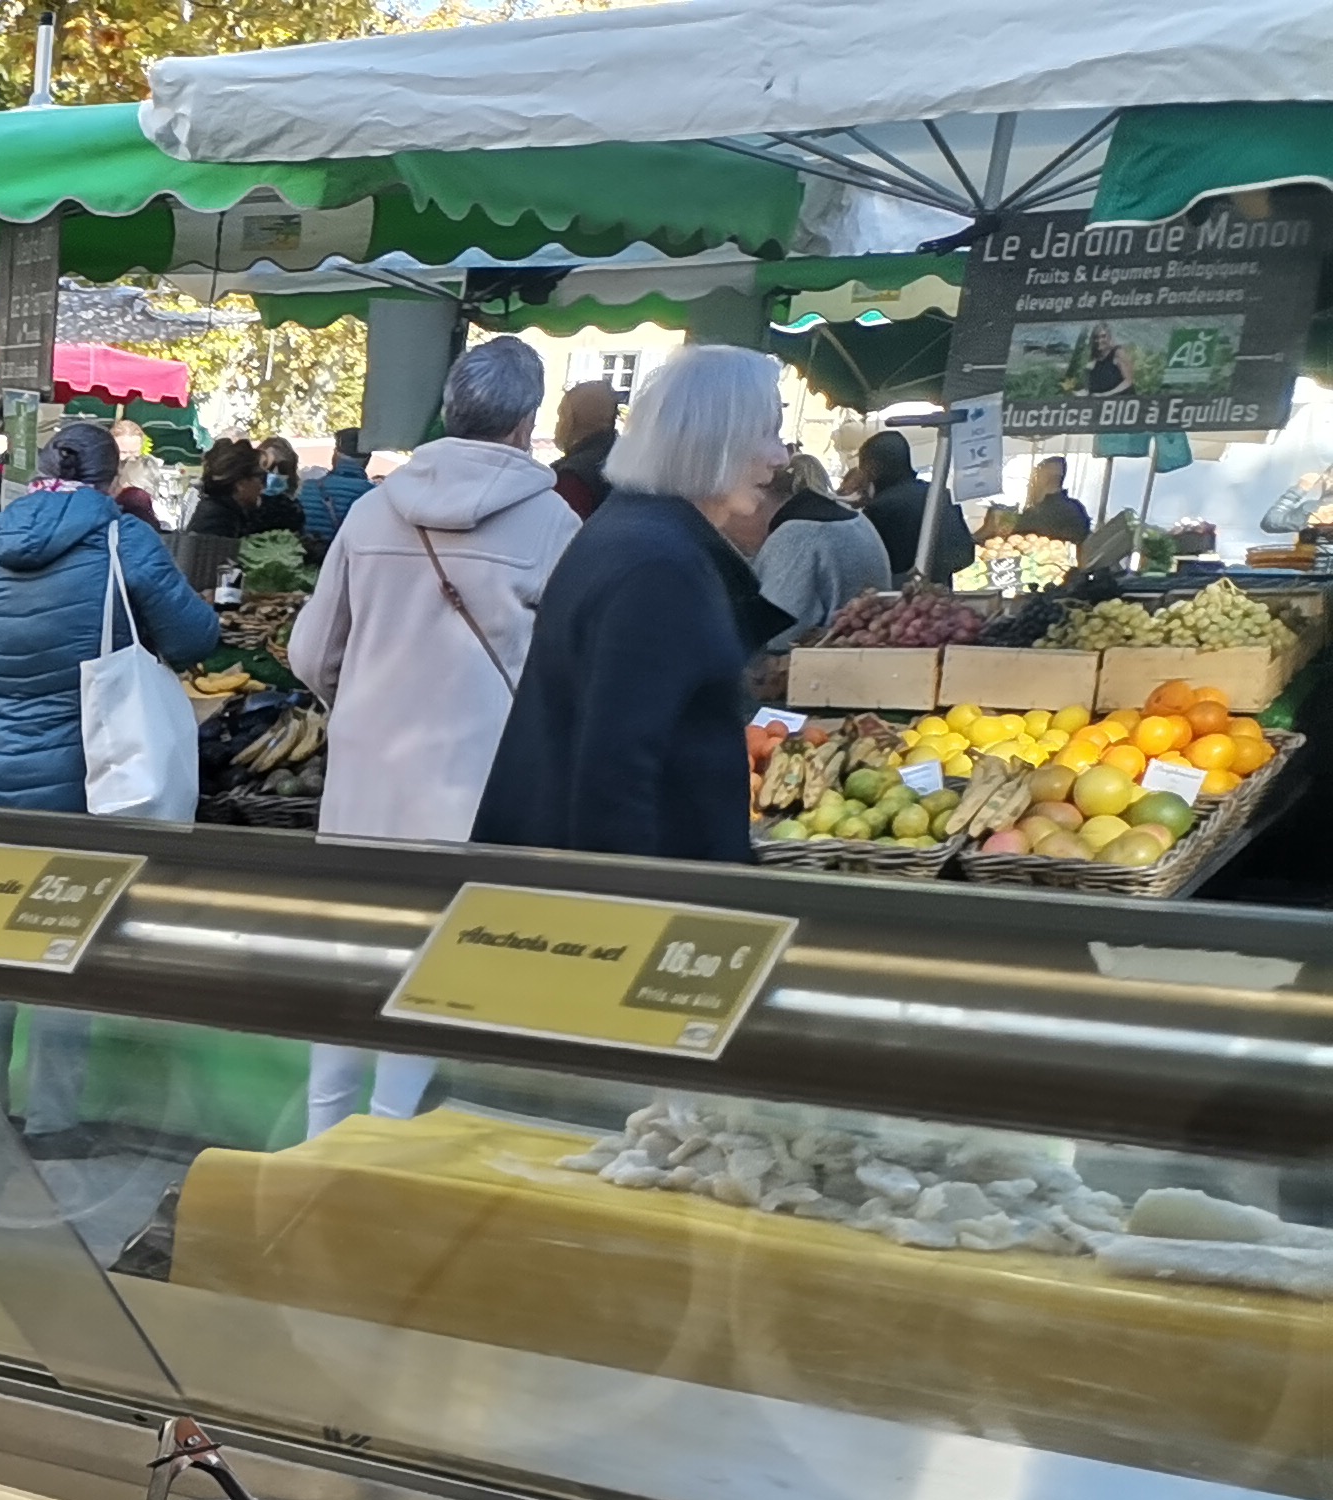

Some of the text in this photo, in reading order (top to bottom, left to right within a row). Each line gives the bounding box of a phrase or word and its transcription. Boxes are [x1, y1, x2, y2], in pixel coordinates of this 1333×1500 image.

[983, 211, 1312, 264] Le Jardin de Manon
[1025, 267, 1071, 286] Fruits
[1074, 265, 1088, 283] &
[1092, 261, 1162, 285] Légumes
[1015, 292, 1074, 313] élevage
[1076, 292, 1098, 310] de
[1100, 289, 1153, 309] Poules
[1156, 286, 1245, 305] Pondeuses
[1168, 340, 1210, 369] AB
[1098, 399, 1141, 425] BIO
[1144, 399, 1160, 425] à
[1166, 395, 1261, 428] Eguilles
[92, 876, 112, 896] €
[457, 925, 549, 953] Anchois
[551, 940, 588, 958] au
[589, 944, 629, 963] sel
[729, 944, 752, 972] €
